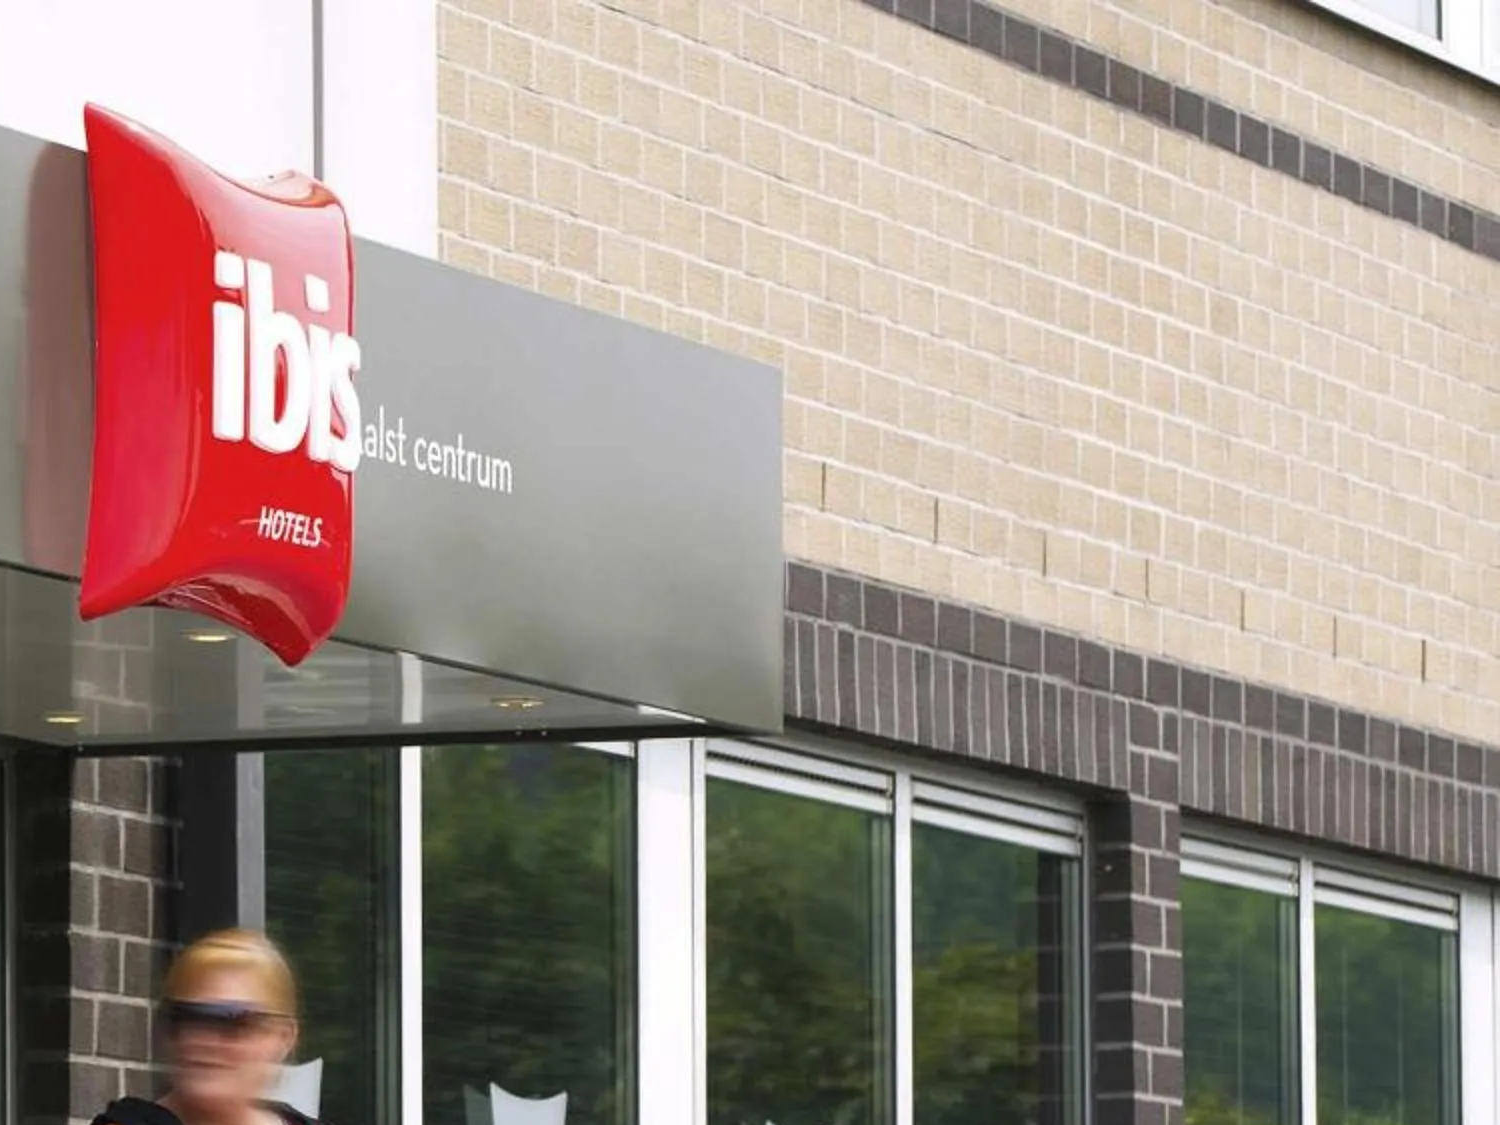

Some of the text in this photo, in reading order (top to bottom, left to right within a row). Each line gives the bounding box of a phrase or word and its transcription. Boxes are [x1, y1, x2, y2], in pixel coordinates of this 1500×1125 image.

[213, 251, 362, 473] ibis
[360, 405, 512, 494] alst centrum
[257, 505, 323, 548] HOTELS
